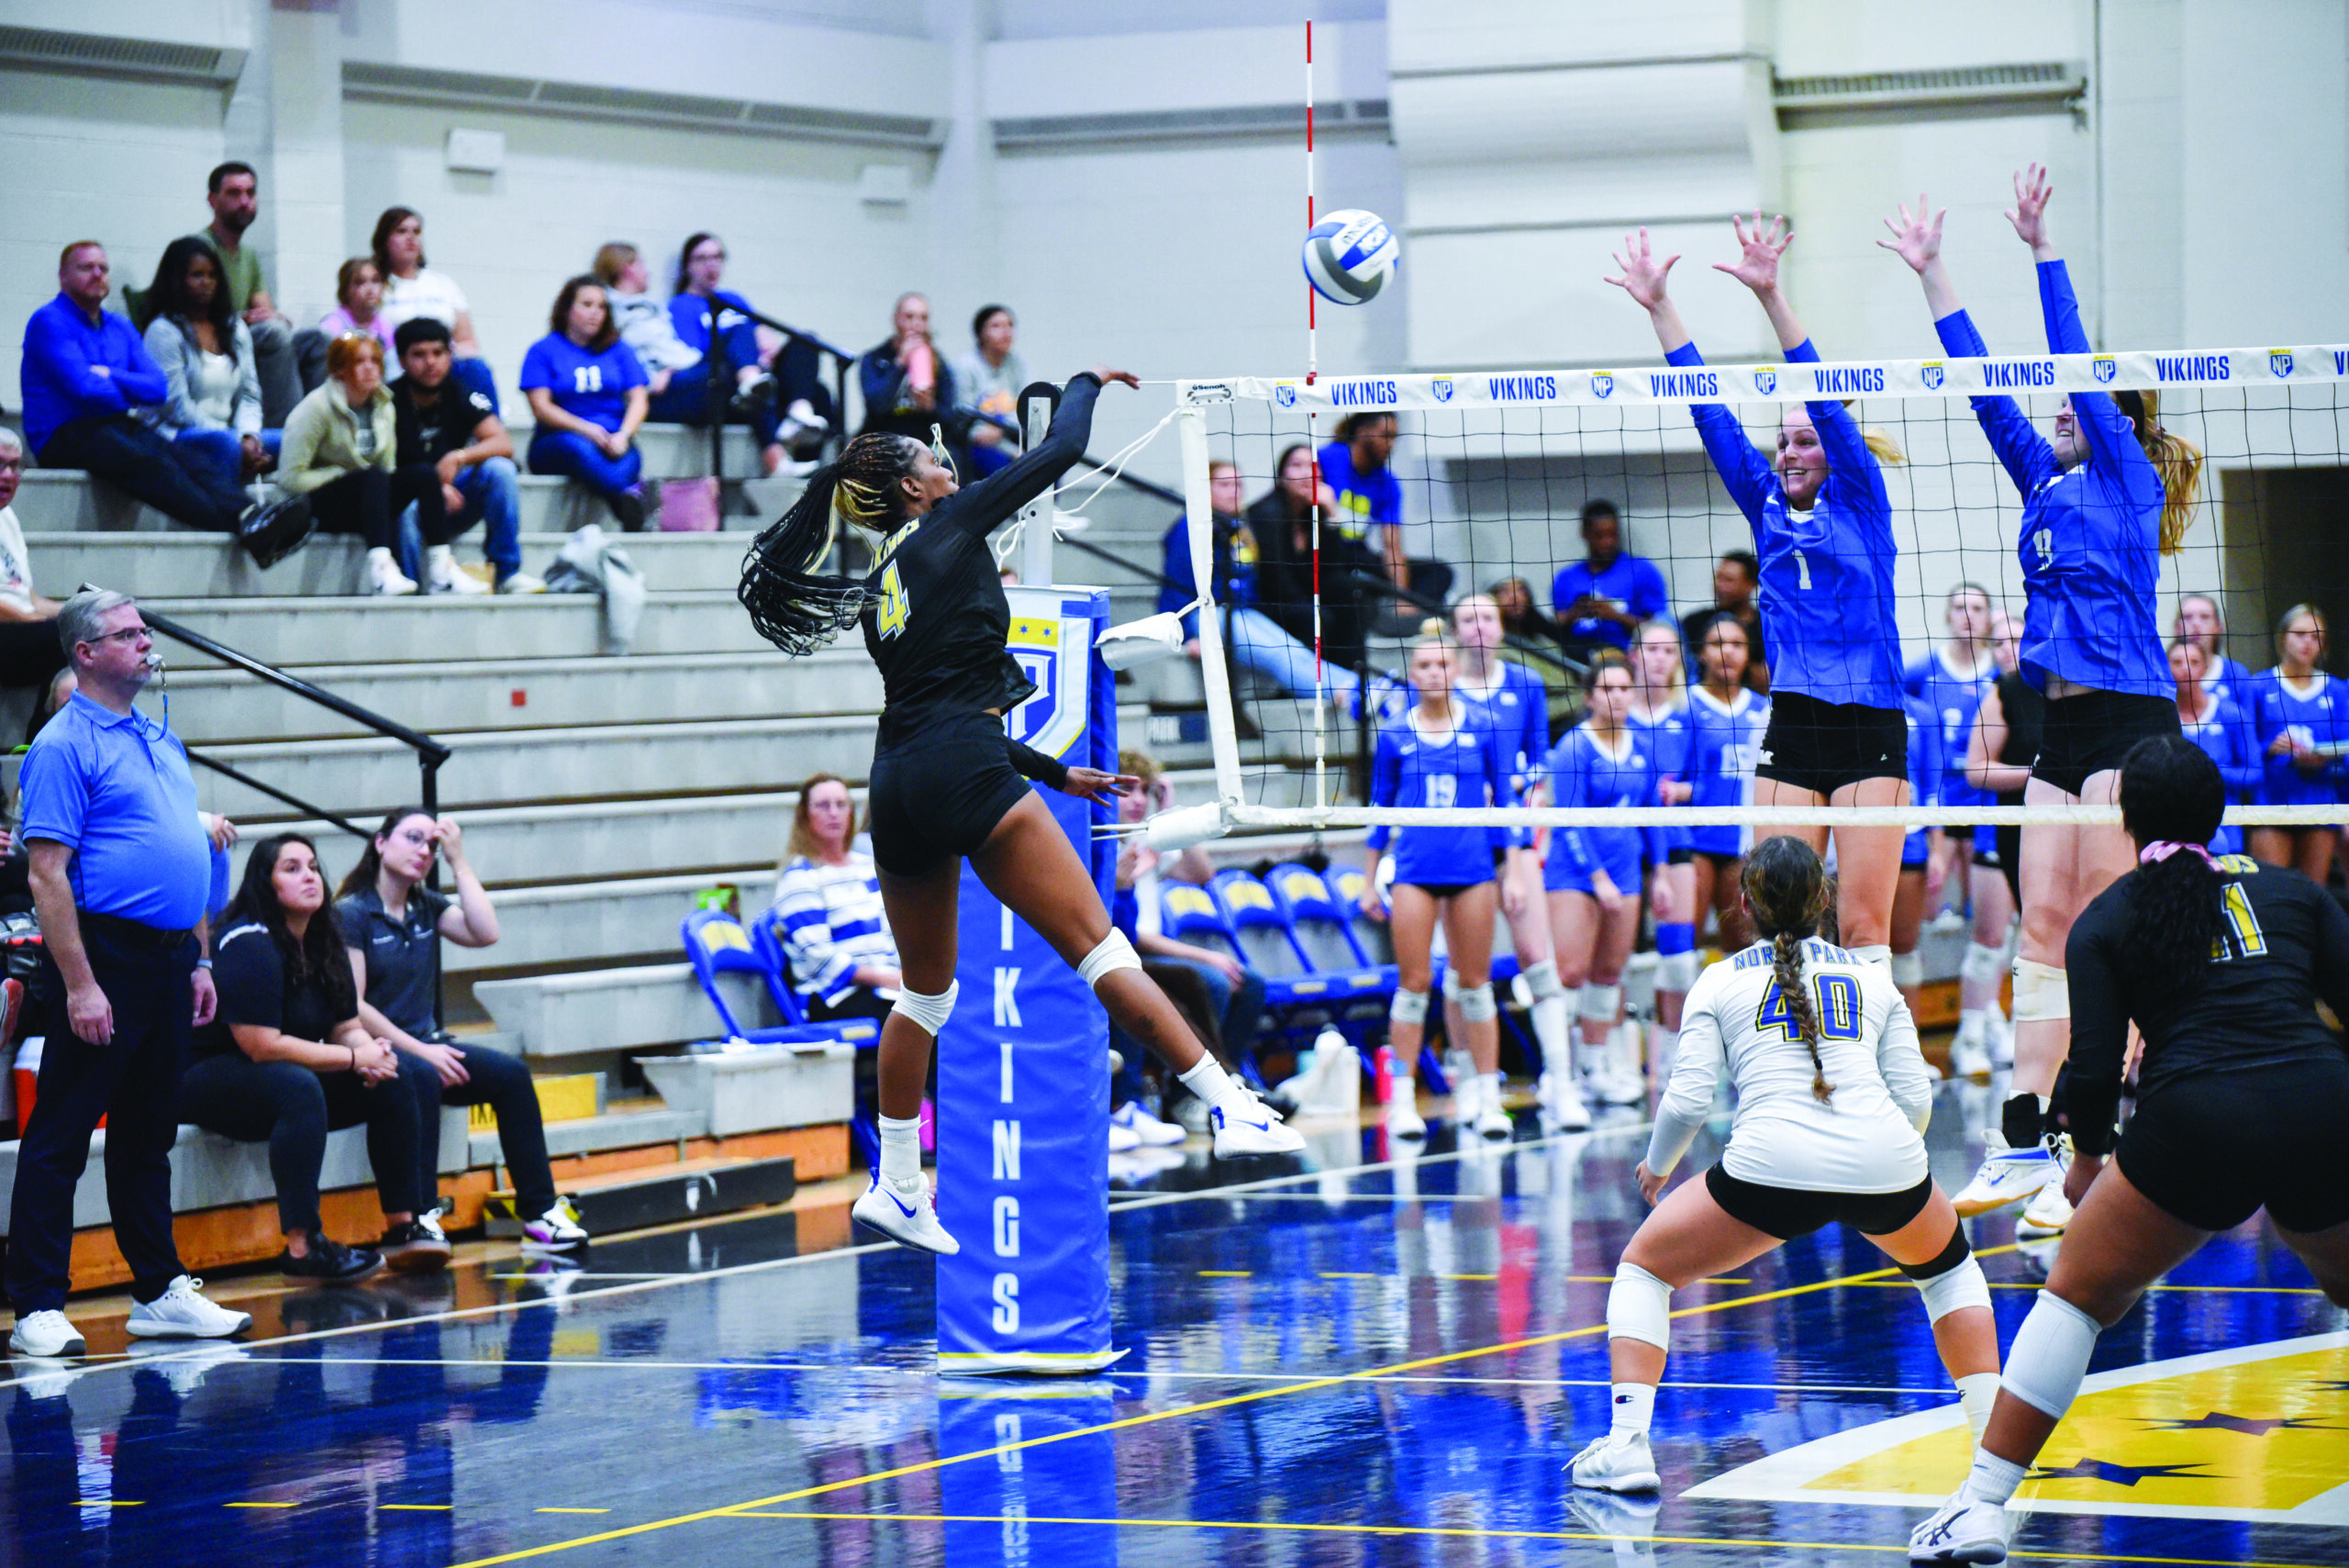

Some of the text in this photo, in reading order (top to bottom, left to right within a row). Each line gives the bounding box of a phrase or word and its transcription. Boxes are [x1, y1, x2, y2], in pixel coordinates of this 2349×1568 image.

[1922, 368, 1943, 389] NP
[1983, 361, 2054, 387] VIKINGS
[2095, 361, 2115, 382] NP
[2156, 356, 2230, 381] VIKINGS
[2272, 355, 2292, 377] NP
[573, 365, 602, 394] 11
[1433, 381, 1453, 401] NP
[1489, 376, 1556, 400] VIKINGS
[1593, 377, 1612, 398] NP
[1651, 373, 1718, 397] VIKINGS
[1755, 373, 1776, 395] NP
[1814, 368, 1884, 393] VIKINGS
[1276, 386, 1296, 406] NP
[1331, 381, 1397, 406] VIKINGS
[2032, 528, 2054, 571] 9
[1792, 549, 1812, 590] 1
[876, 558, 911, 641] 4
[1733, 945, 1776, 972] NOR
[1755, 972, 1863, 1042] 40
[992, 903, 1022, 1335] IKINGS
